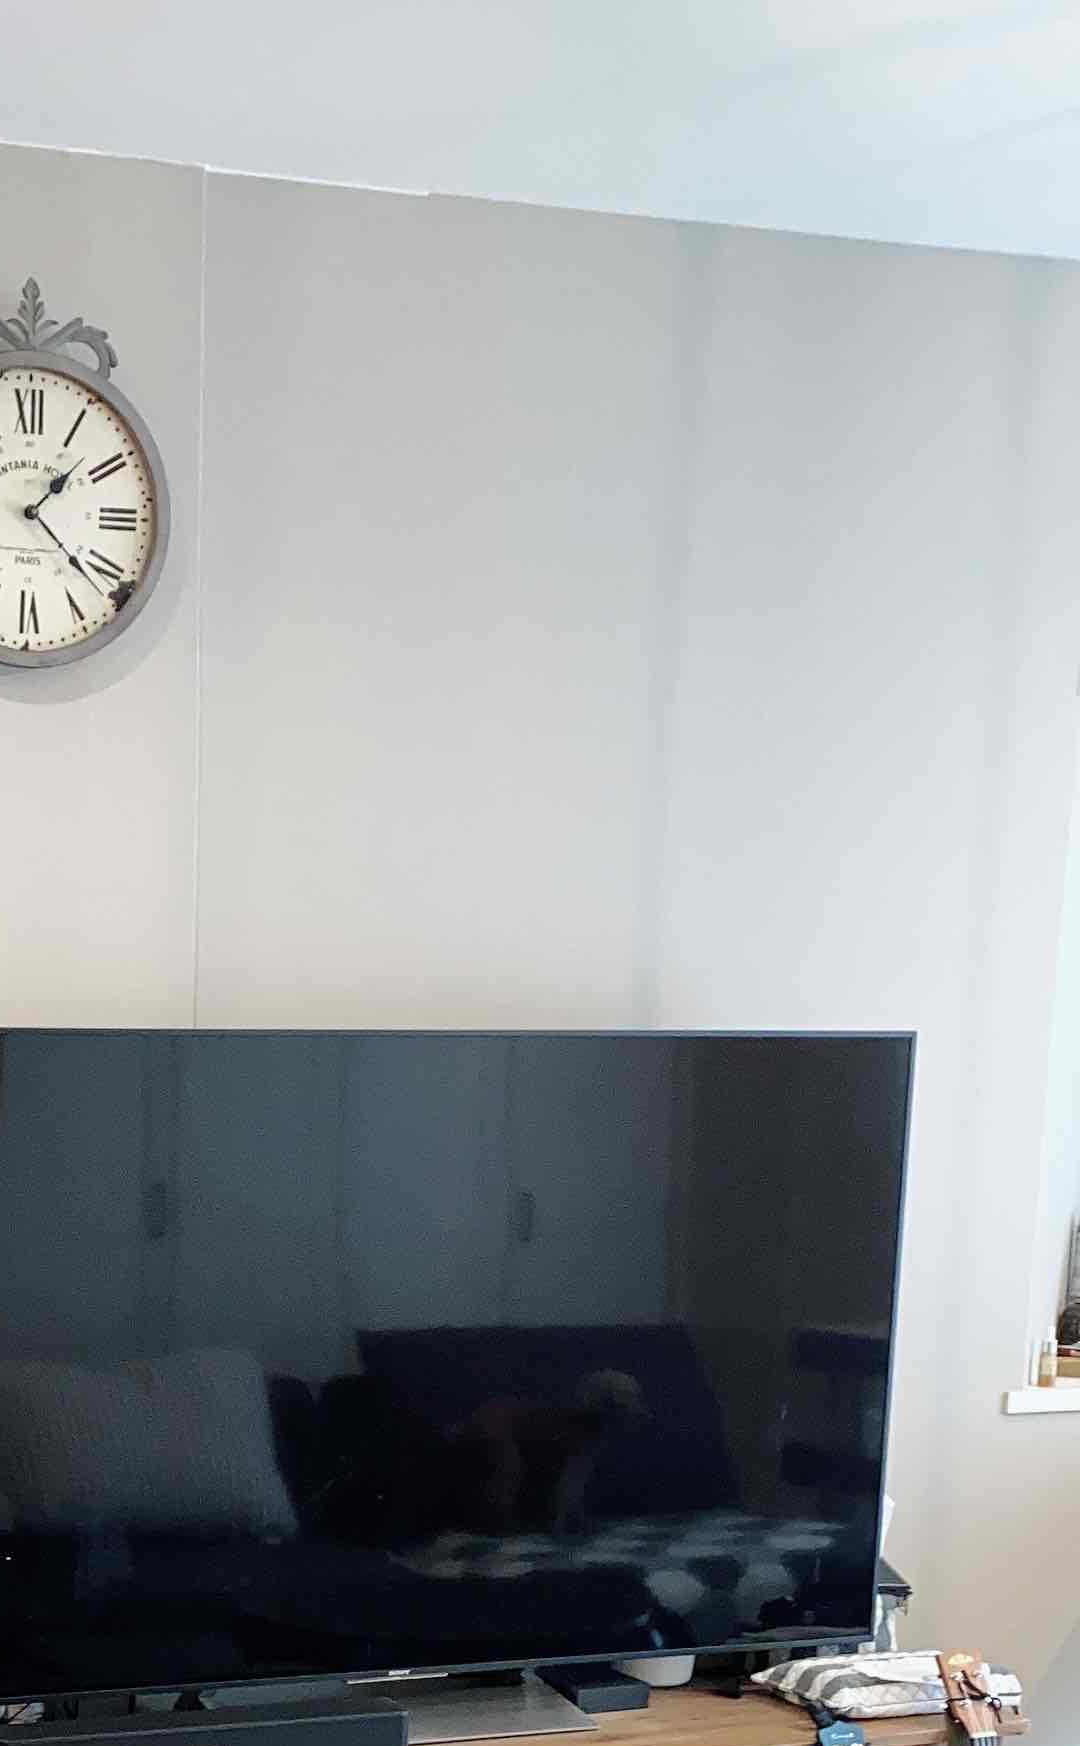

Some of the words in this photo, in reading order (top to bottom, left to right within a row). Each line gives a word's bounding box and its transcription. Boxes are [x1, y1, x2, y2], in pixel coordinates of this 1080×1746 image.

[14, 387, 44, 435] XII
[63, 408, 86, 448] I
[88, 452, 126, 483] II
[98, 507, 137, 531] III
[14, 555, 41, 565] PARIS
[84, 549, 124, 588] IV
[19, 589, 39, 634] VI
[64, 585, 85, 624] V
